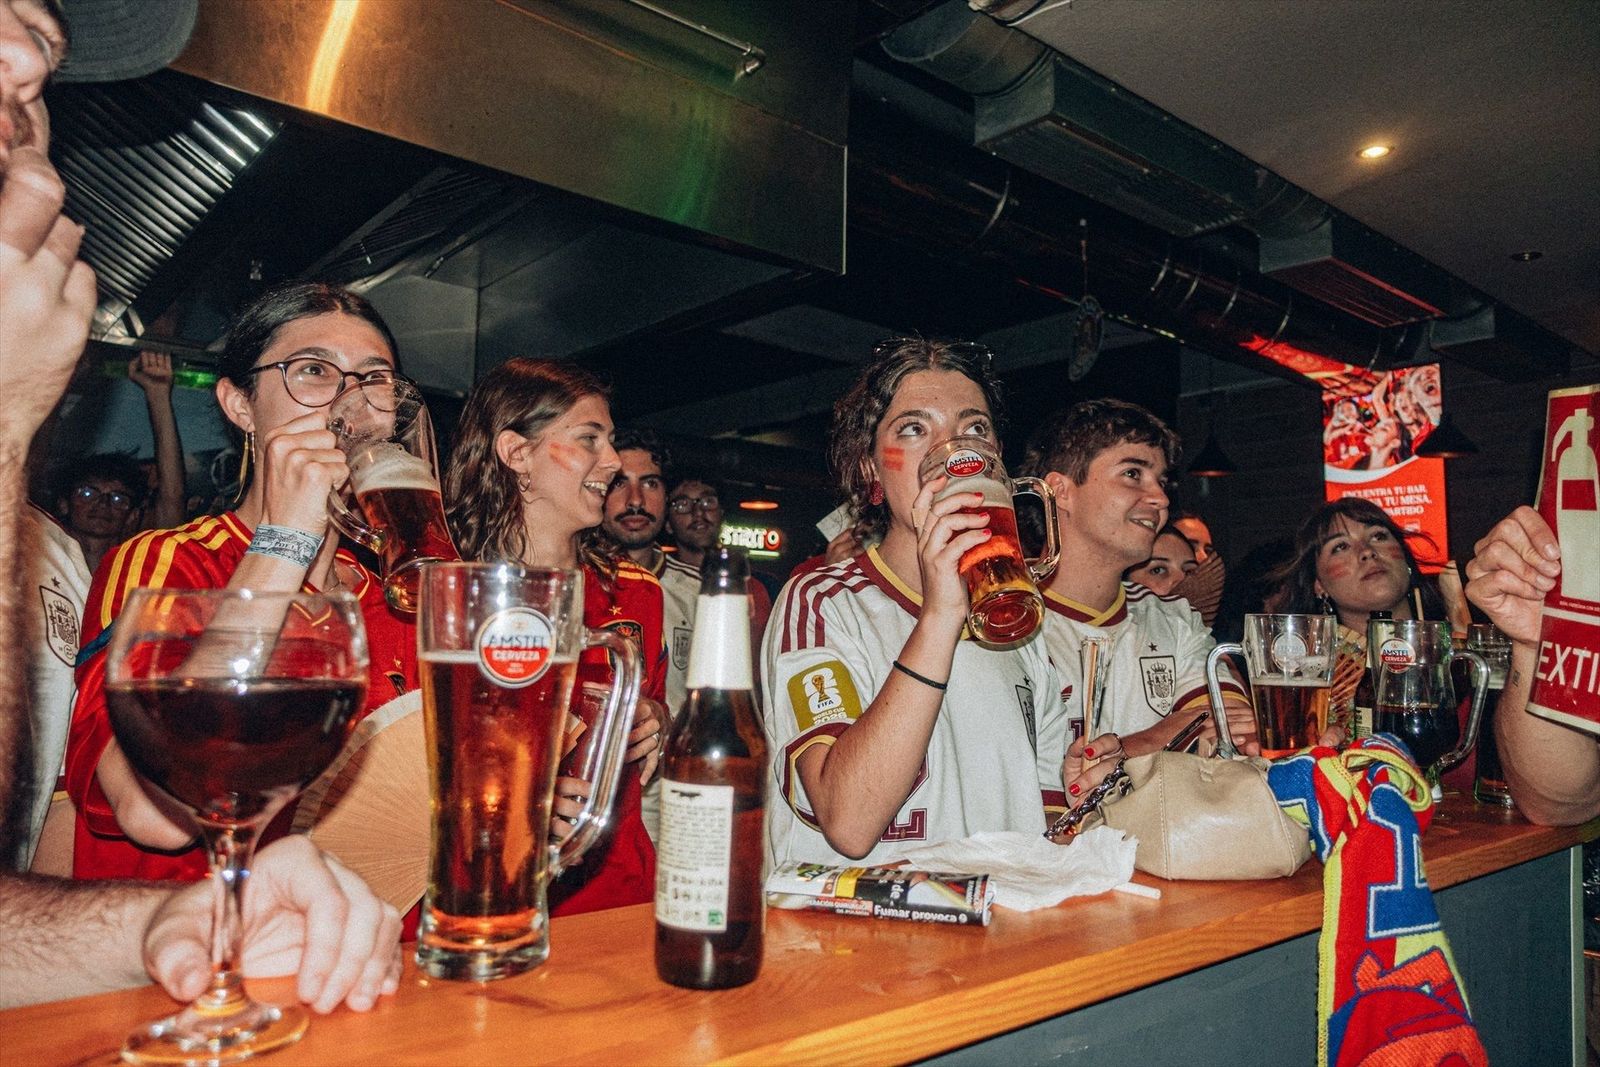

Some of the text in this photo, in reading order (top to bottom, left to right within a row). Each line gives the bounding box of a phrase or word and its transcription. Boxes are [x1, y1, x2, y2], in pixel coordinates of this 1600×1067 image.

[953, 462, 979, 471] CERVEZA
[1394, 486, 1406, 495] TU
[1385, 497, 1398, 506] TU
[491, 650, 540, 661] CERVEZA
[1536, 640, 1600, 695] EXTI
[817, 699, 834, 709] FIFA
[812, 706, 846, 721] WORLD CUP
[874, 904, 911, 919] Fumar
[911, 910, 957, 923] provoca
